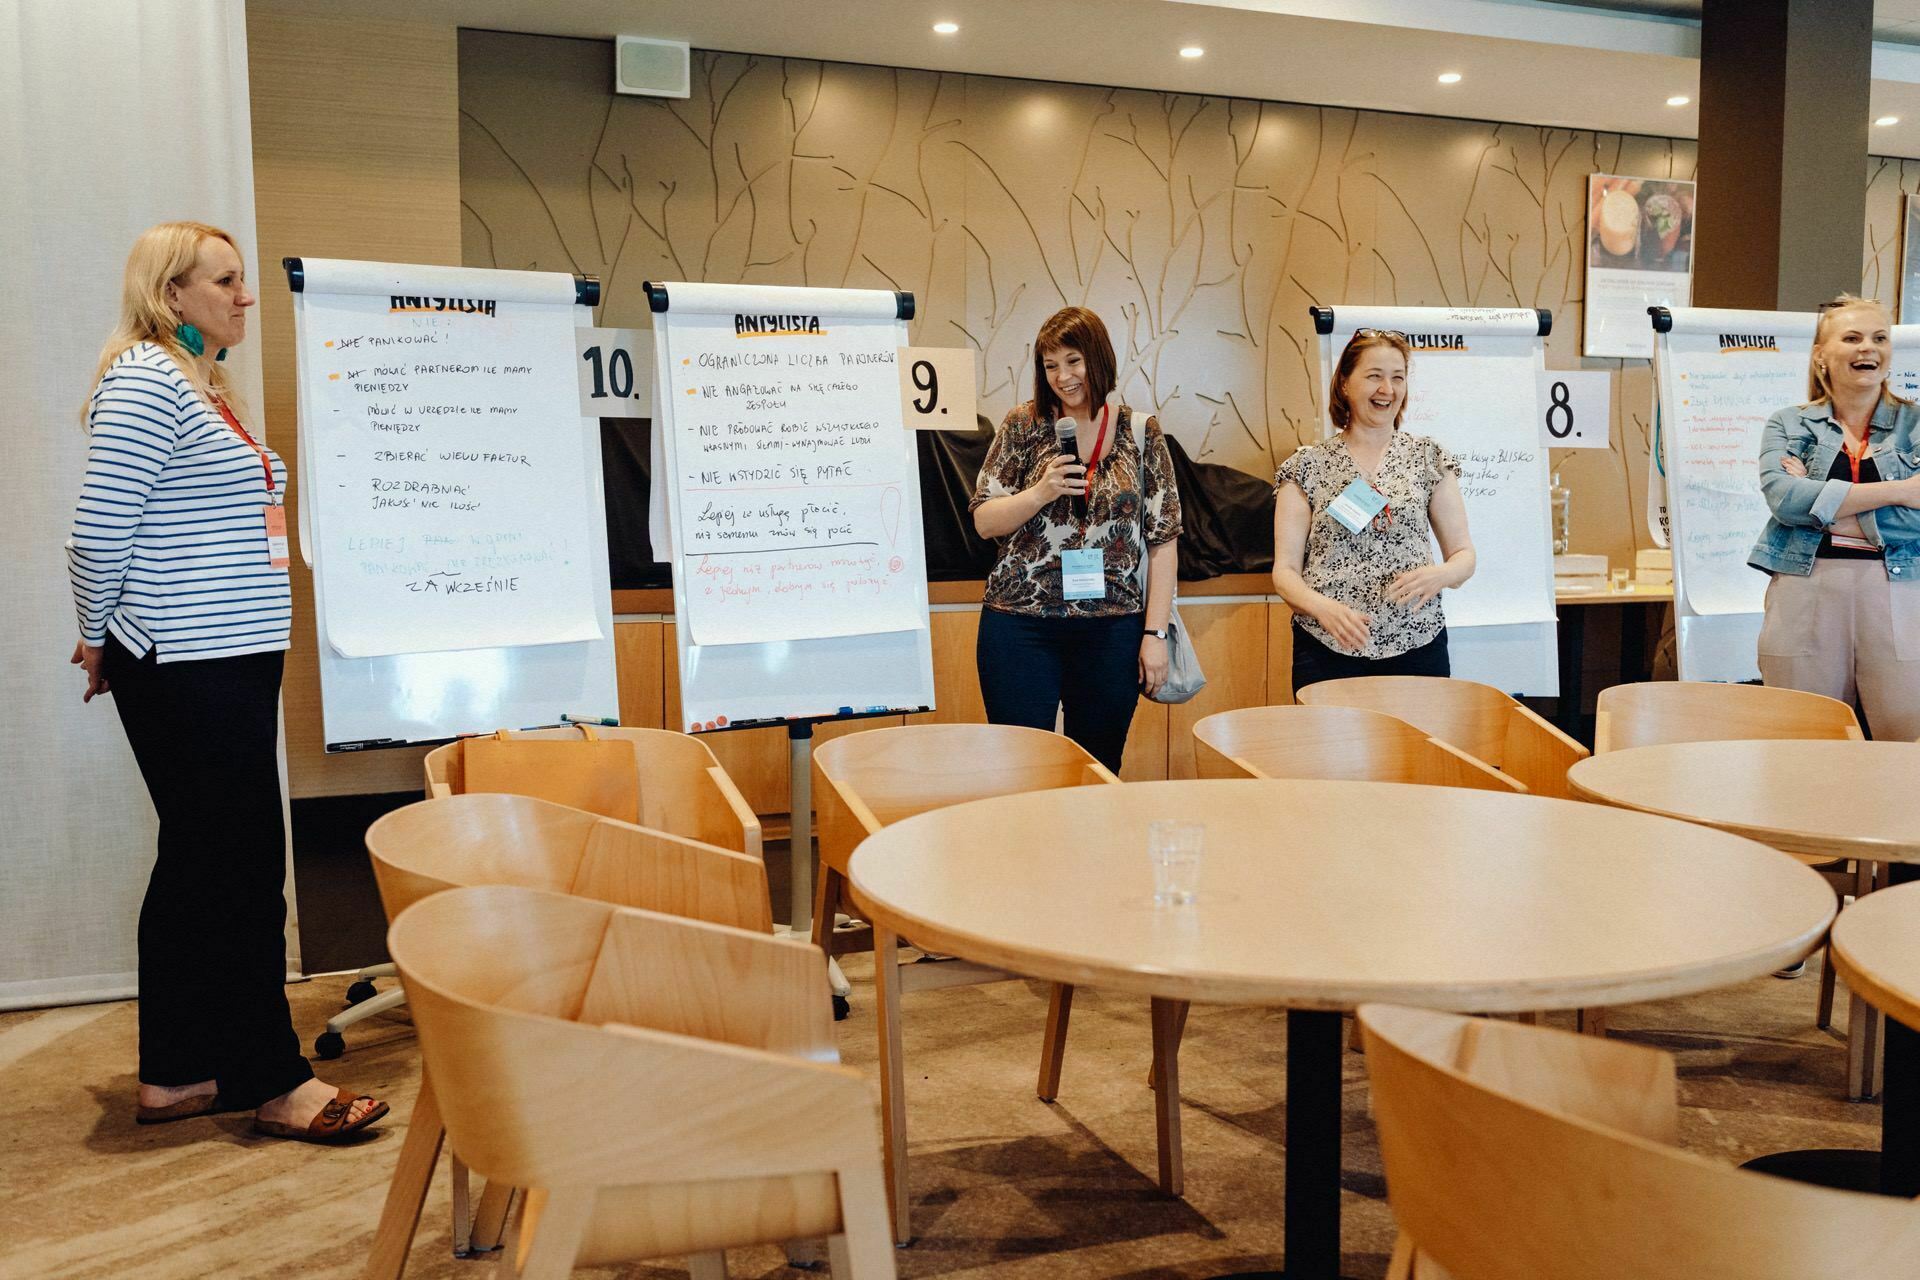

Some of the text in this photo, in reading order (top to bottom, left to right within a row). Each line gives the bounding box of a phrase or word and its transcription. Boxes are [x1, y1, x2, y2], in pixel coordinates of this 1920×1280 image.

[734, 313, 820, 334] ANTYLISTA
[1719, 334, 1776, 350] ANTYLISTA
[414, 364, 479, 376] PARTNEROM
[503, 366, 533, 375] MAMY
[698, 352, 779, 370] OGRANICZONA
[583, 346, 640, 400] 10.
[354, 383, 409, 394] PIENIĘDZY
[702, 385, 718, 399] NIE
[912, 360, 948, 414] 9.
[404, 407, 413, 415] W
[490, 406, 519, 415] MAMY
[1546, 381, 1583, 438] 8.
[370, 421, 421, 434] PIENIĘDZY
[699, 425, 719, 436] NIE
[374, 449, 429, 462] ZBIERAĆ
[483, 453, 532, 467] FAKTUR
[701, 471, 722, 485] NIE
[789, 464, 809, 485] SIĘ
[816, 460, 854, 479] PYTAĆ
[698, 501, 736, 527] Lepiej
[405, 576, 519, 594] ZA WCZEŚNIE
